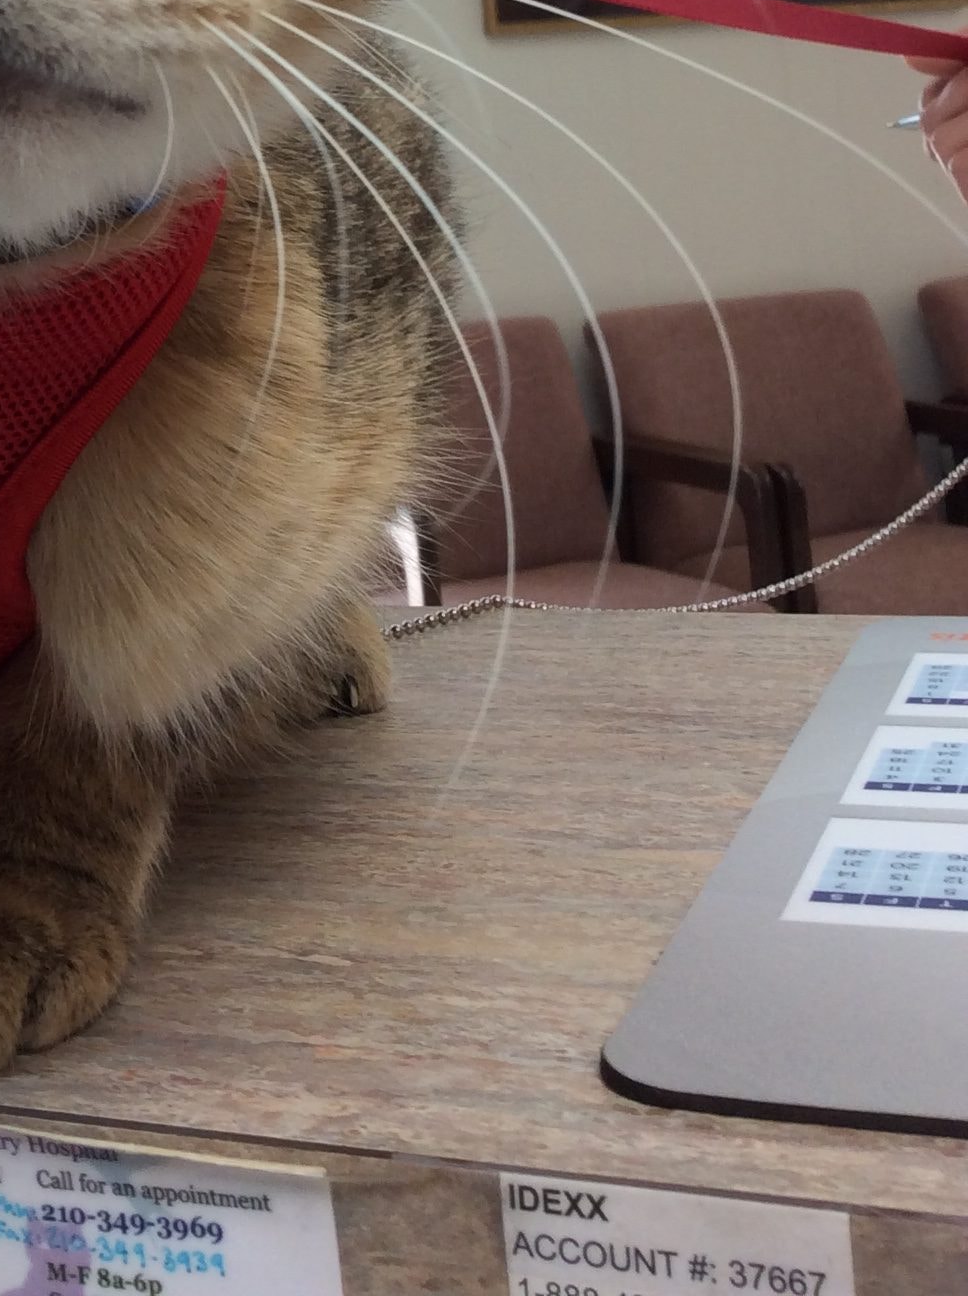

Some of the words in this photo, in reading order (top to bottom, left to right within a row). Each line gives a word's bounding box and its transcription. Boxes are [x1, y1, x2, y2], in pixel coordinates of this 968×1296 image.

[36, 1169, 73, 1192] Call
[79, 1172, 106, 1195] for
[111, 1184, 136, 1198] an
[140, 1184, 273, 1213] appointment
[509, 1183, 609, 1222] IDEXX
[41, 1204, 224, 1245] 210-349-3969
[46, 1261, 91, 1285] M-F
[96, 1267, 163, 1296] 8a-6p
[512, 1230, 679, 1278] ACCOUNT
[688, 1253, 718, 1285] #:
[728, 1259, 827, 1296] 37667
